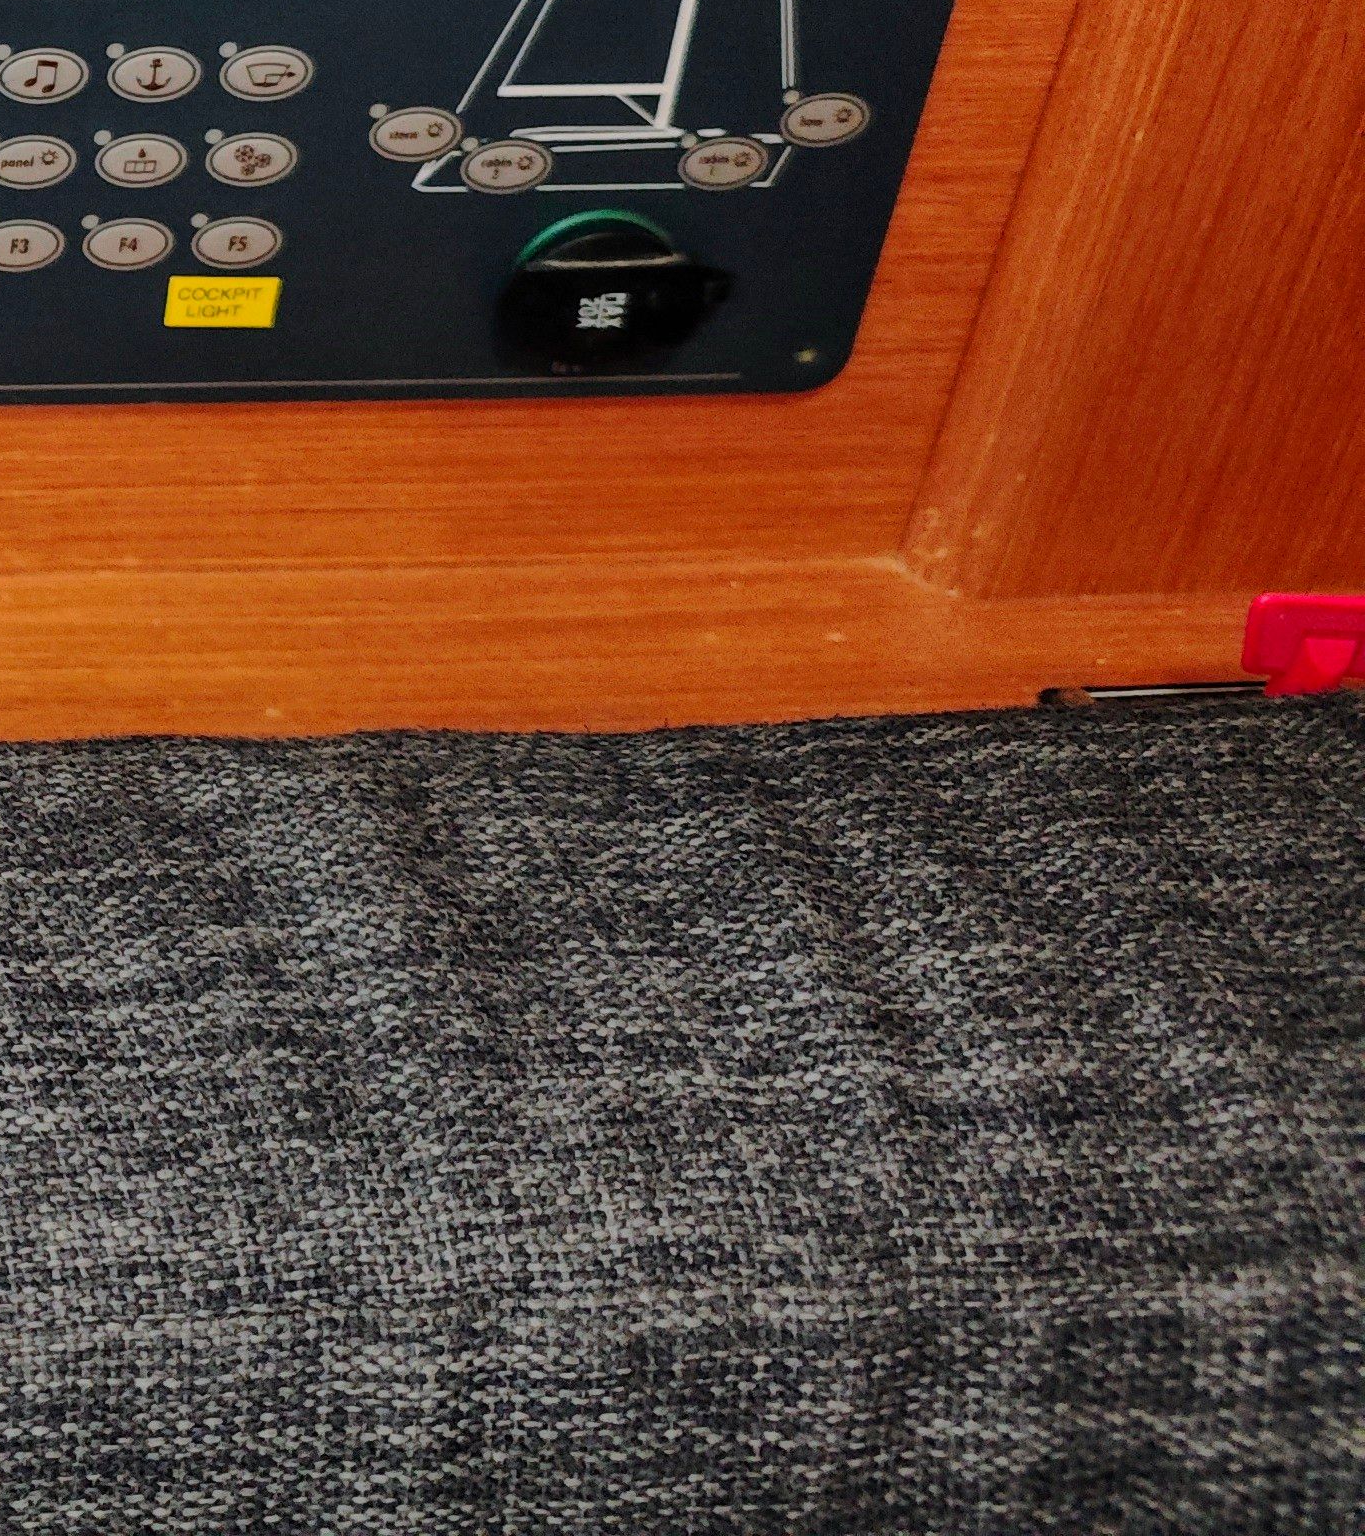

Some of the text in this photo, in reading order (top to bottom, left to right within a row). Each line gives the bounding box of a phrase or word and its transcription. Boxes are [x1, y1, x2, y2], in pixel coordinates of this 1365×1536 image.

[0, 156, 35, 170] panel
[10, 238, 30, 254] F3
[119, 237, 139, 253] F4
[227, 236, 248, 251] F5
[177, 287, 264, 301] COCKPIT
[185, 305, 242, 318] LIGHT
